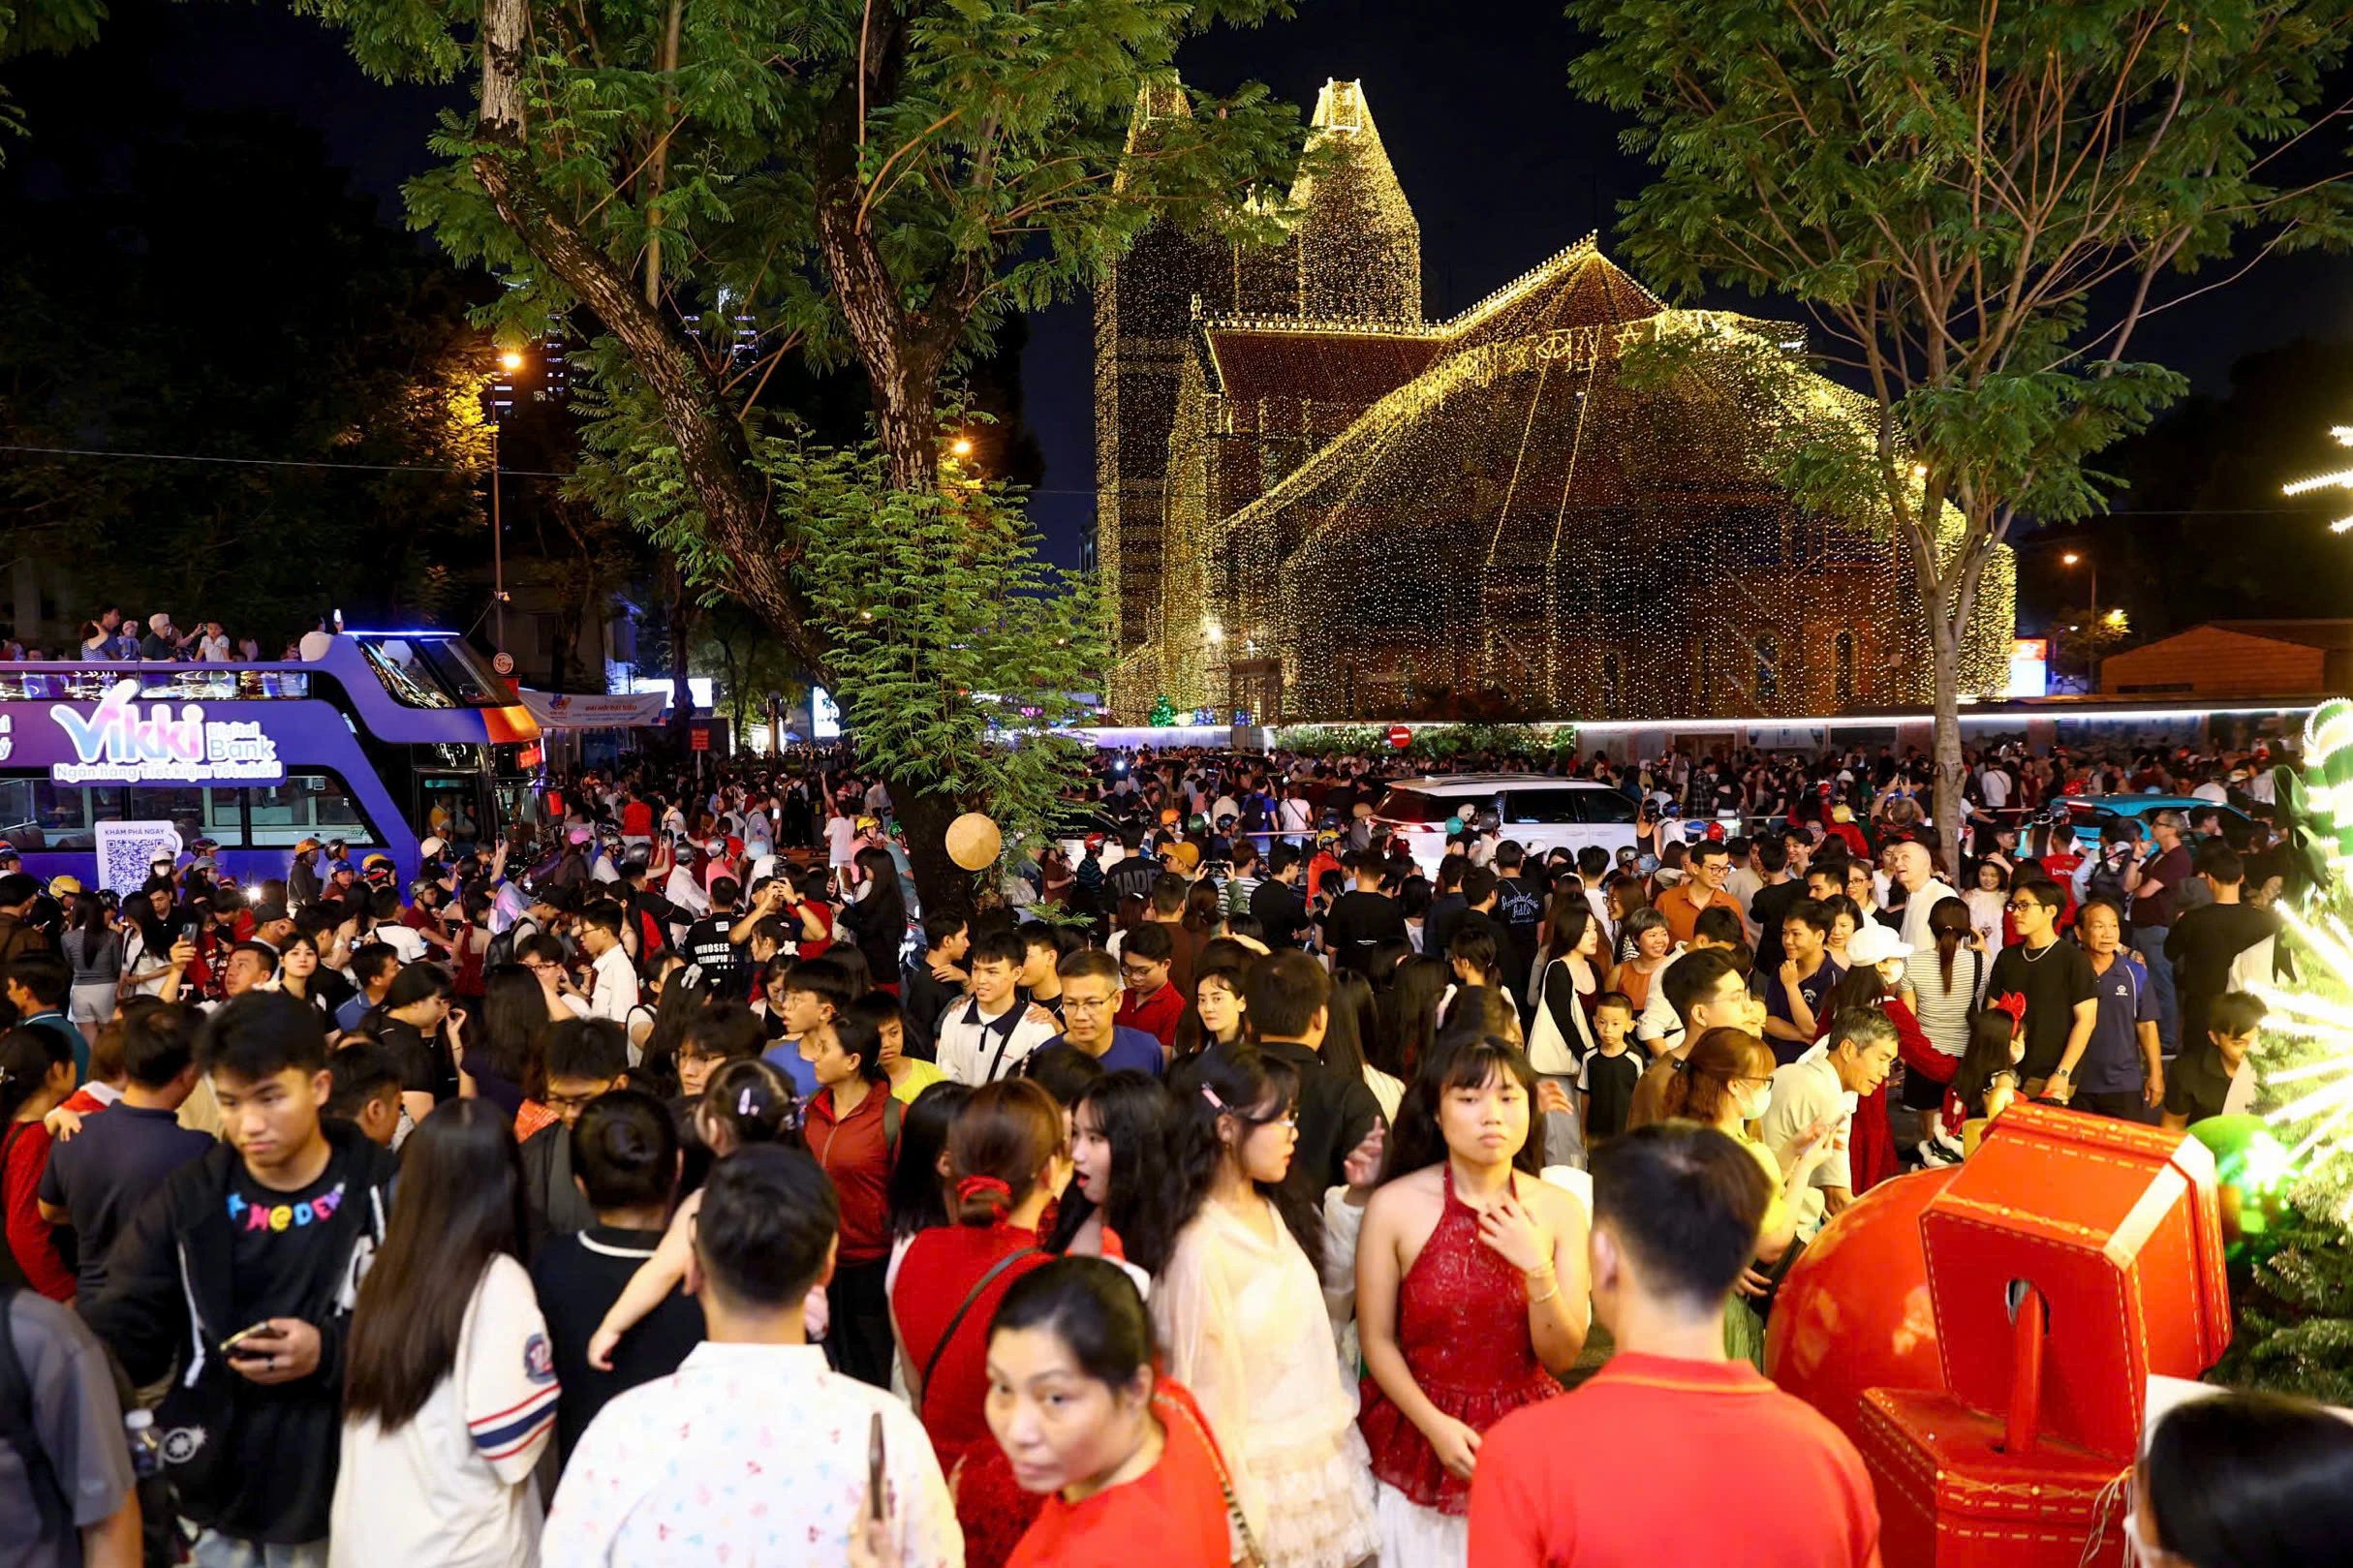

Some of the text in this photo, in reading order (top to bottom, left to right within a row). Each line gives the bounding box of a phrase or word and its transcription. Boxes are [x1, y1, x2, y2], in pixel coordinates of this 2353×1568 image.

[52, 680, 201, 760] Vikki
[209, 736, 274, 758] Bank
[695, 942, 730, 954] WHOSES
[697, 954, 737, 965] CHAMPIO
